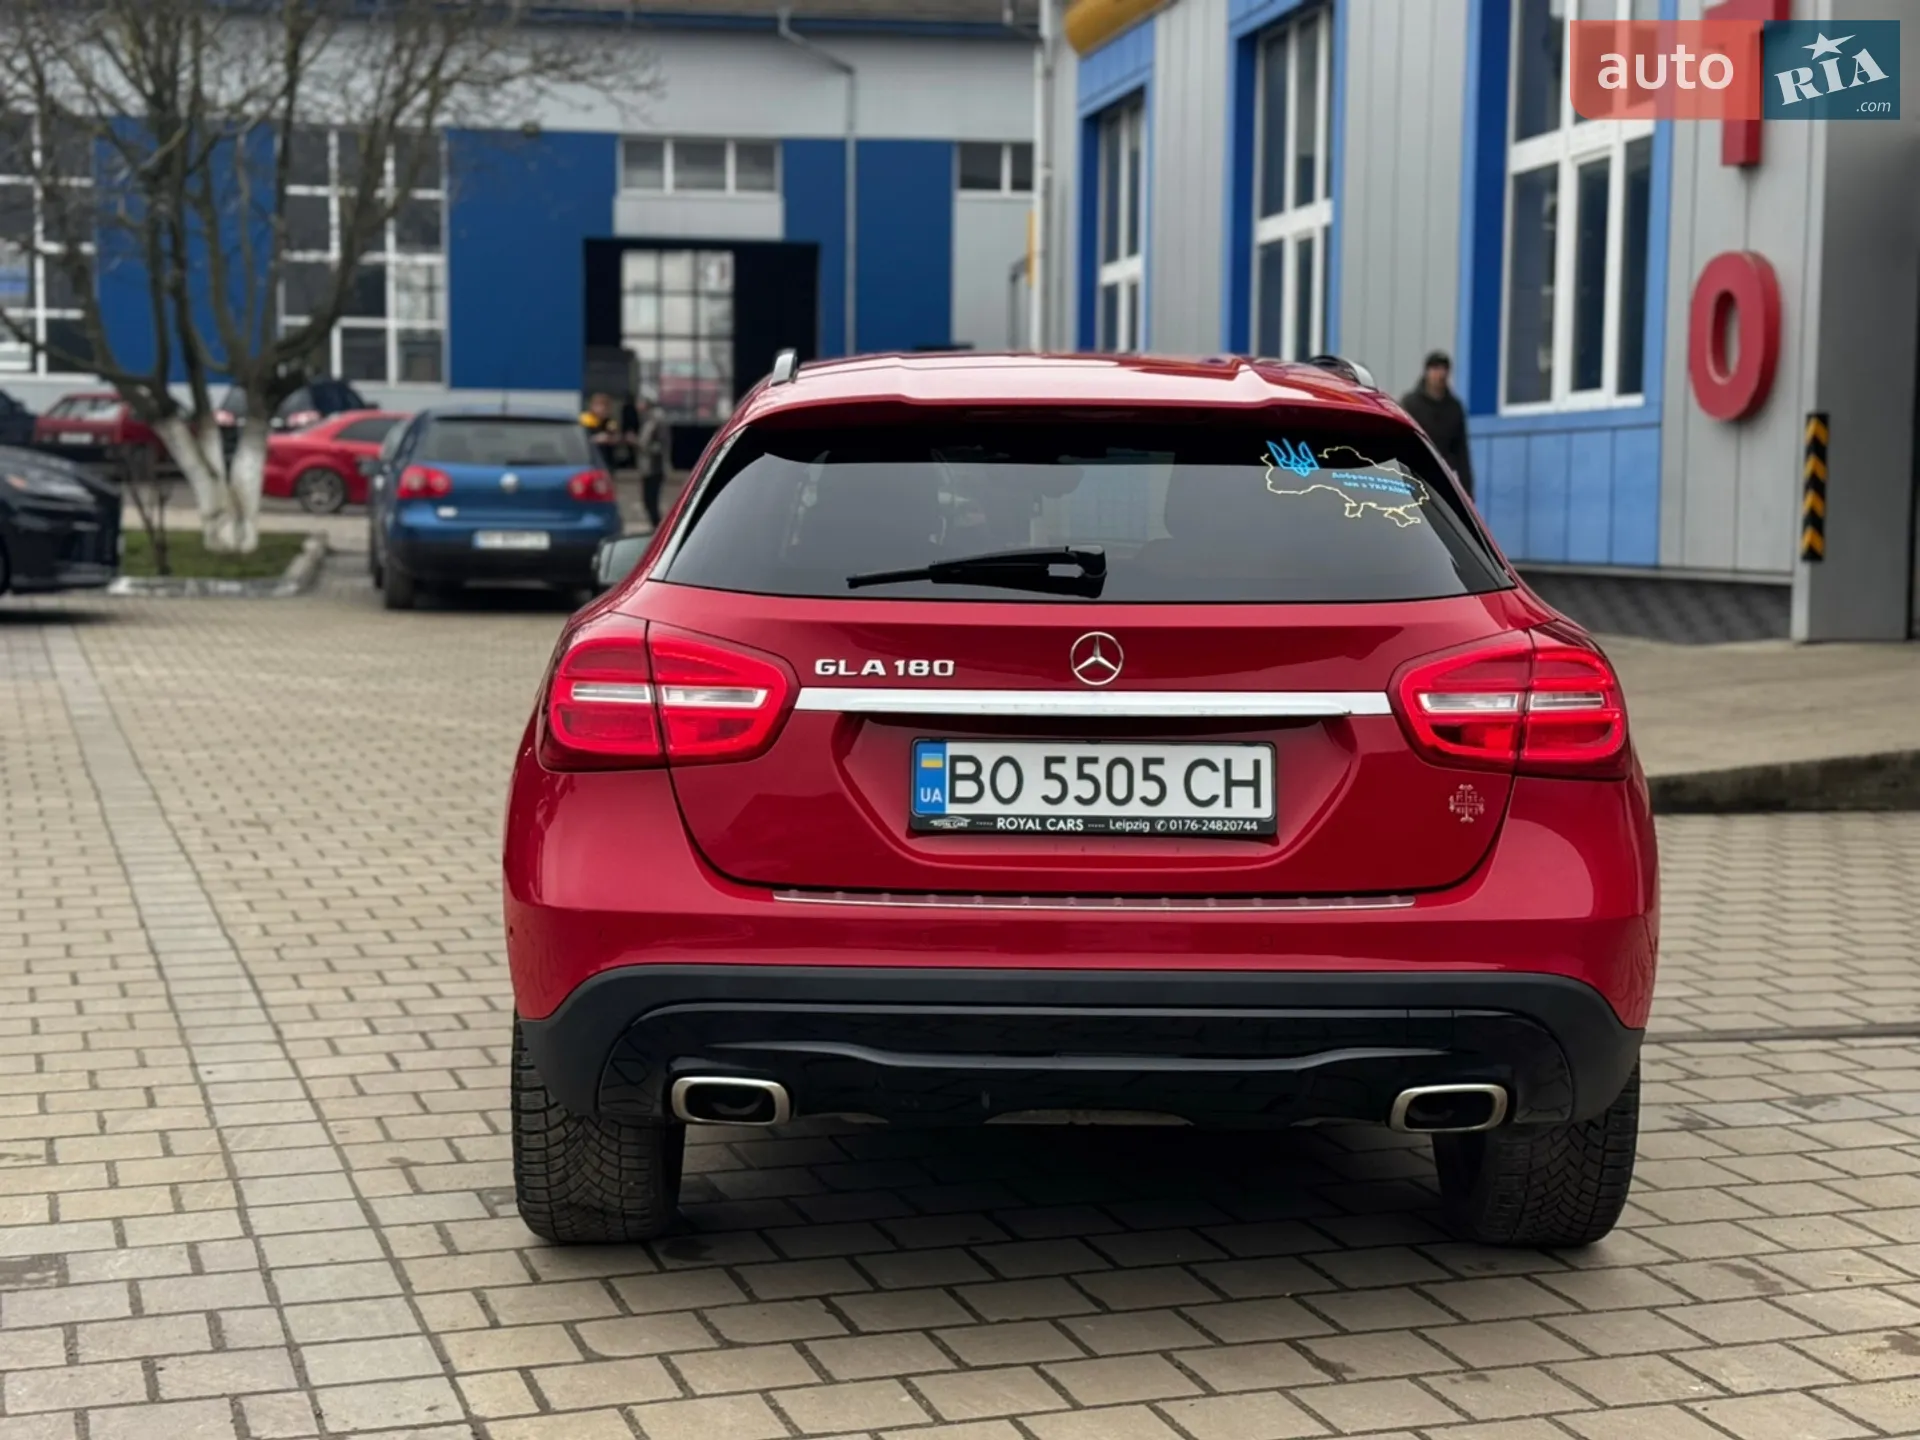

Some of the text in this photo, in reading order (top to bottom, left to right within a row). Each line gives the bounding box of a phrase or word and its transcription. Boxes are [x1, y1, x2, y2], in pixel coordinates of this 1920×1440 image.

[815, 659, 955, 677] GLA 180
[948, 755, 1262, 809] BO 5505 CH
[920, 787, 943, 803] UA
[997, 817, 1258, 833] ROYAL CARS Leipzig 0176-24820744
